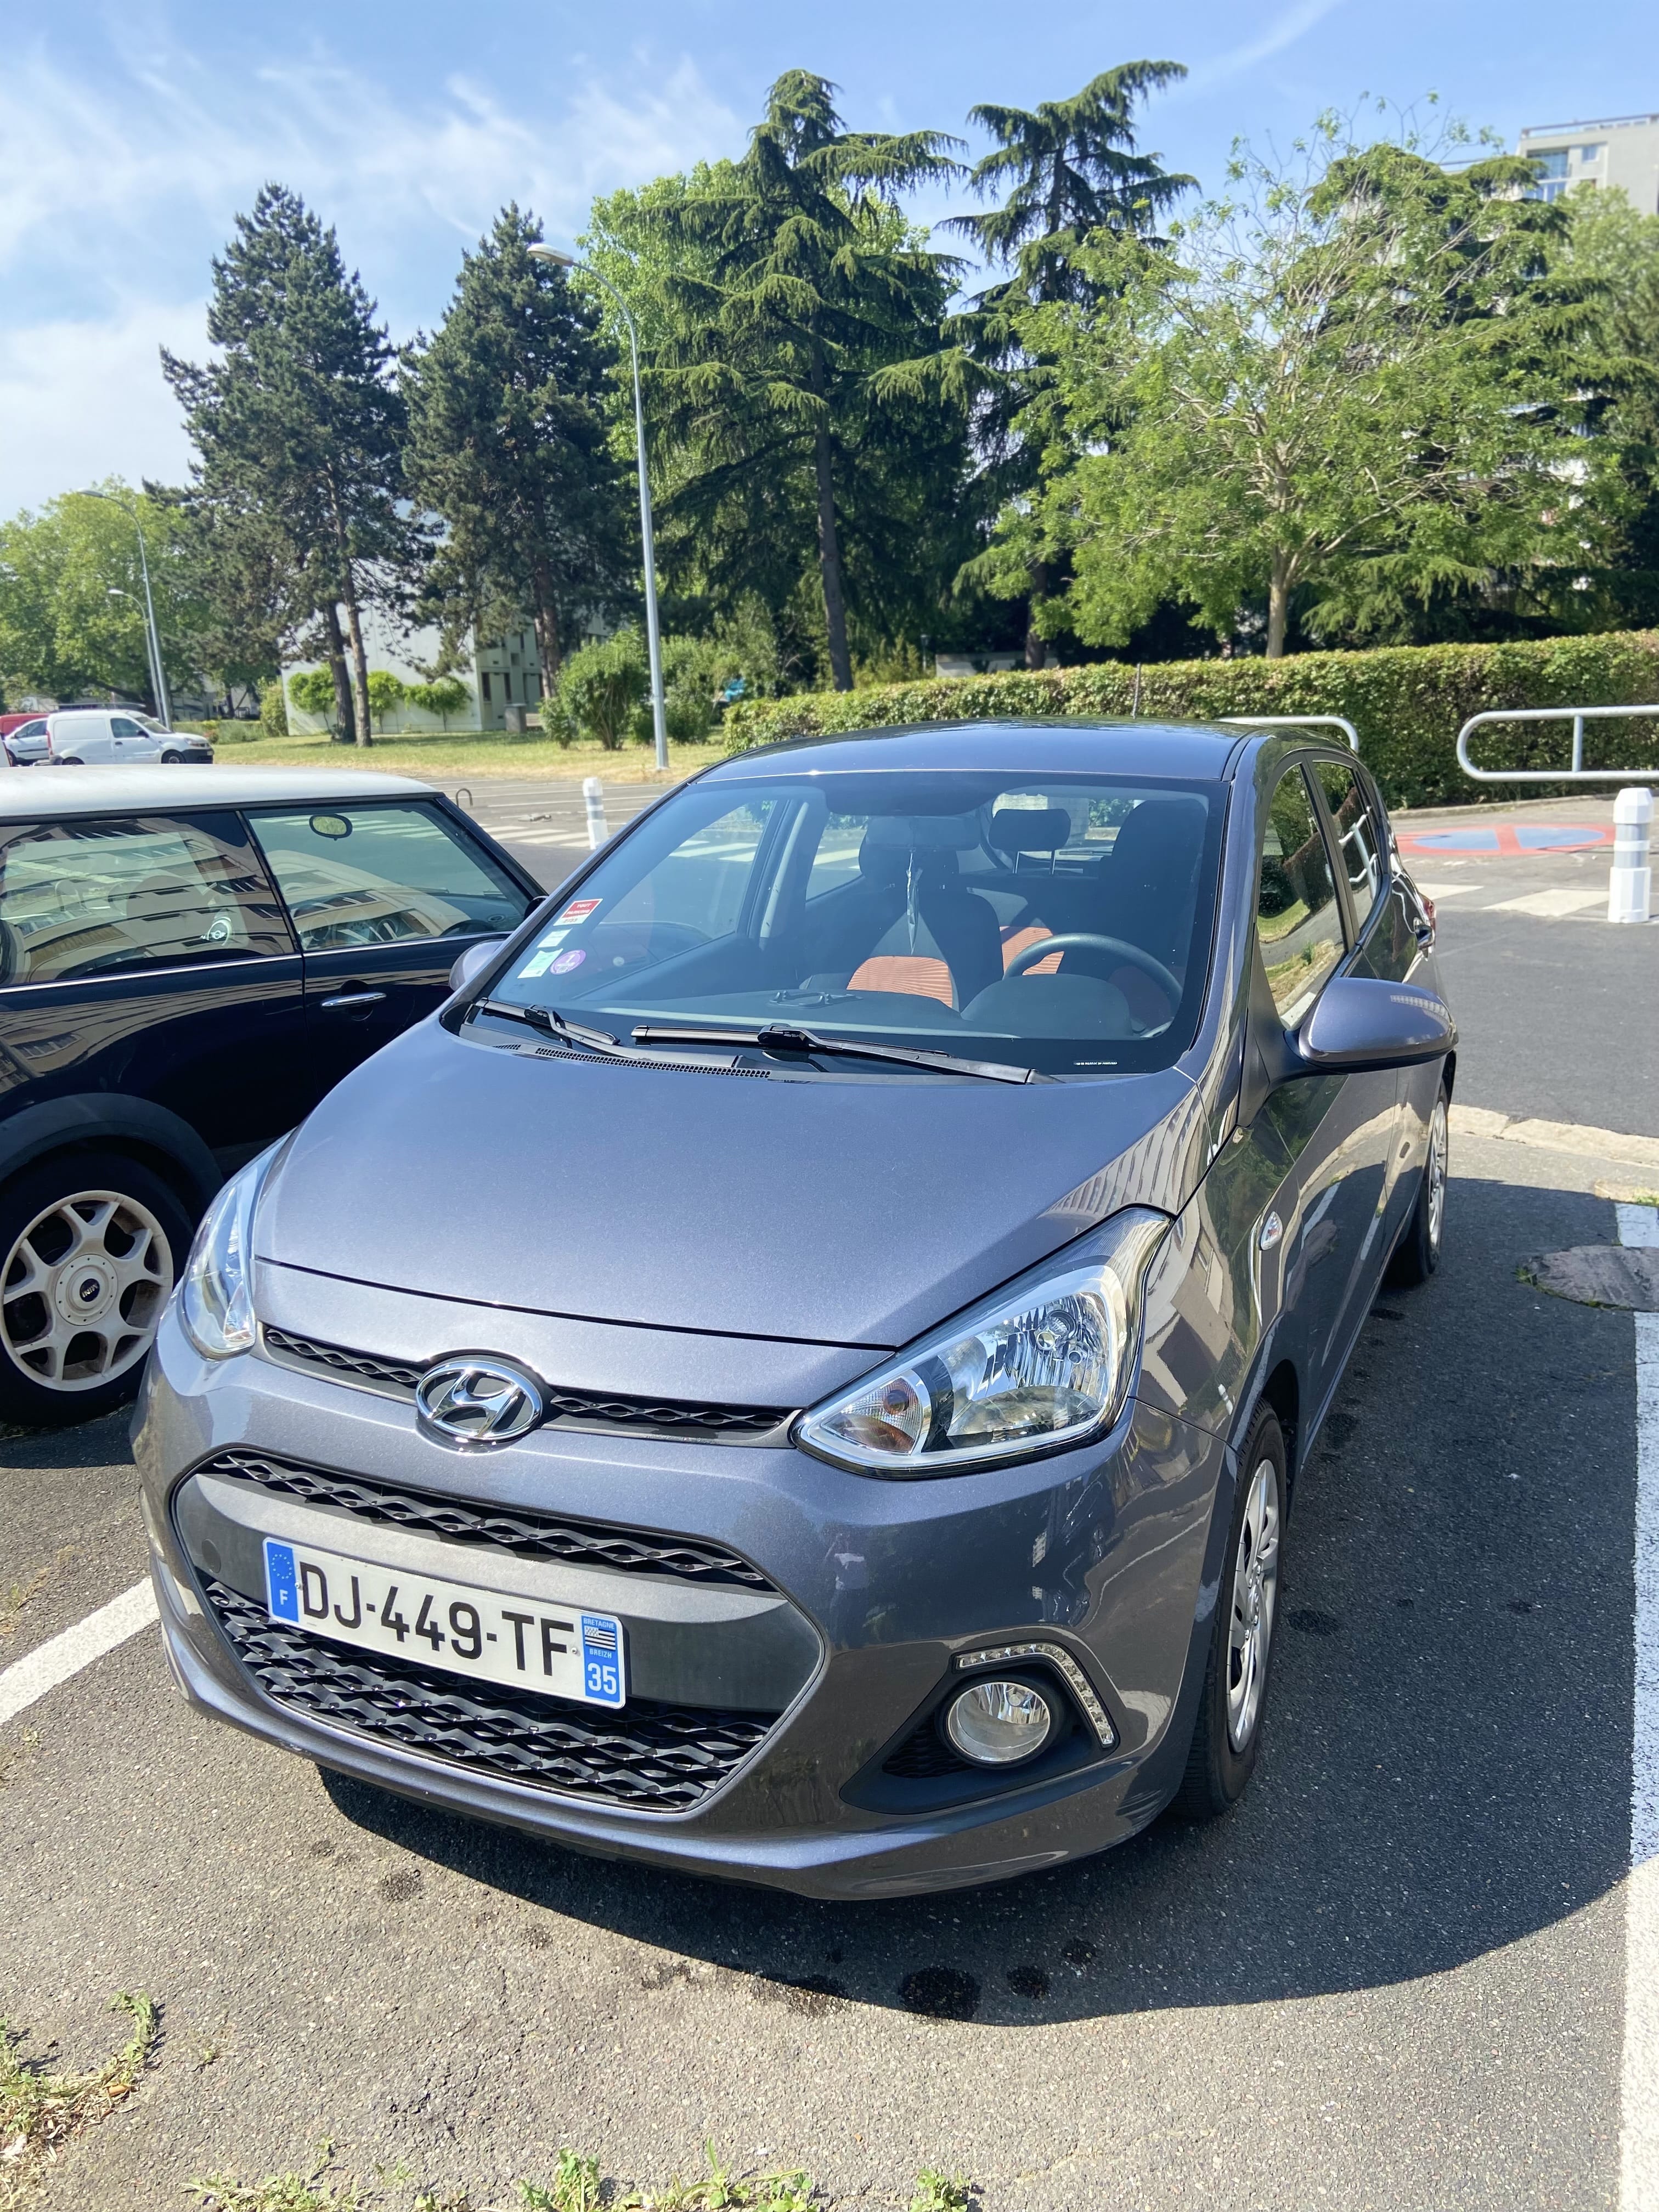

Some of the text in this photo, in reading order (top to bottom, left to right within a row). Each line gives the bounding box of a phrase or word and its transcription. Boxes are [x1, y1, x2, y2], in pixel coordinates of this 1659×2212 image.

[81, 1284, 98, 1297] MINI
[280, 1589, 288, 1605] F
[299, 1561, 574, 1677] DJ-449-TF
[583, 1617, 615, 1629] BRETAGNE
[589, 1648, 612, 1658] BREIZH
[588, 1662, 617, 1695] 35
